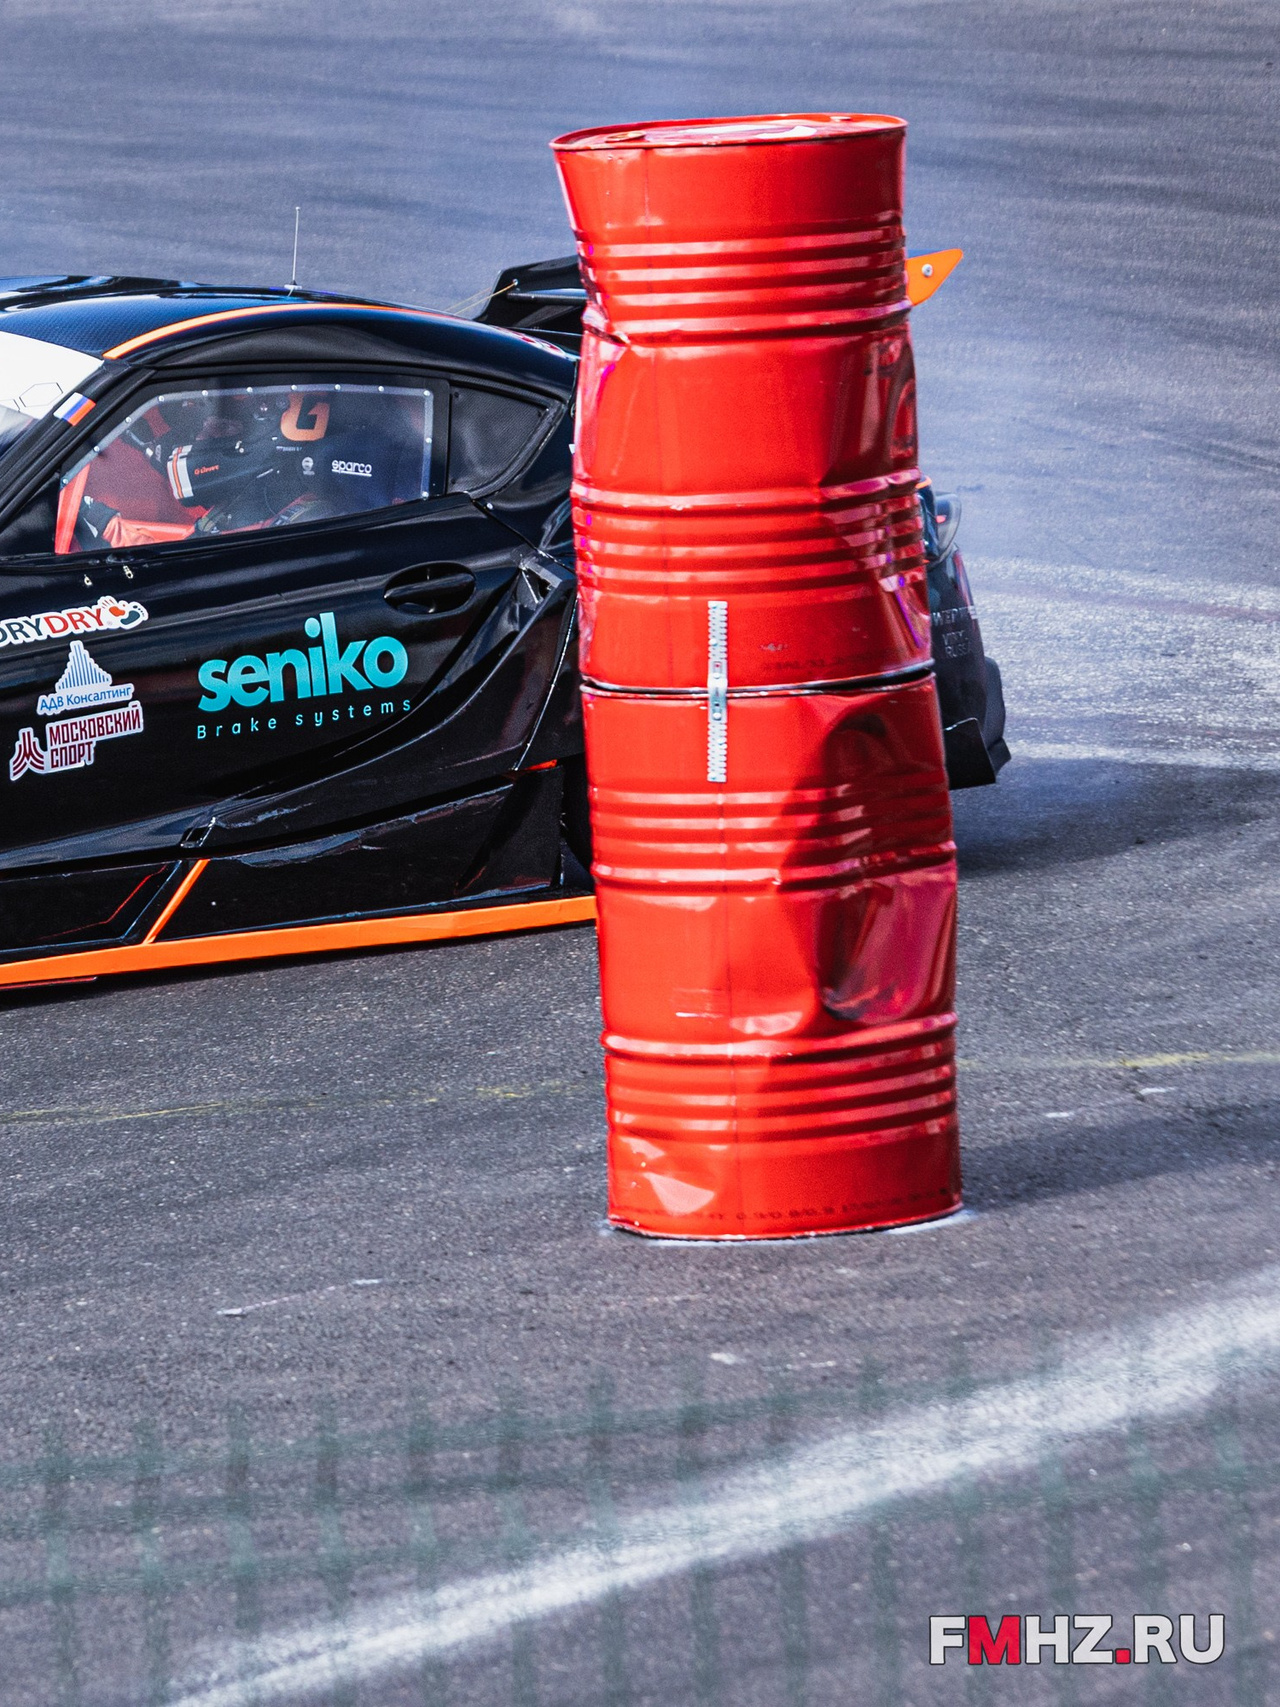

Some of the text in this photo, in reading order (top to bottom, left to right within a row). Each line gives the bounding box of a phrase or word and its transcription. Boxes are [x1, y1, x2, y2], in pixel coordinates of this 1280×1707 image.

[332, 459, 373, 477] sparco
[197, 611, 409, 713] seniko
[39, 686, 132, 713] АДВ Консалтинг
[48, 704, 141, 746] МОСКОВСКИЙ
[196, 698, 412, 740] Brake systems
[50, 741, 93, 769] СПОРТ
